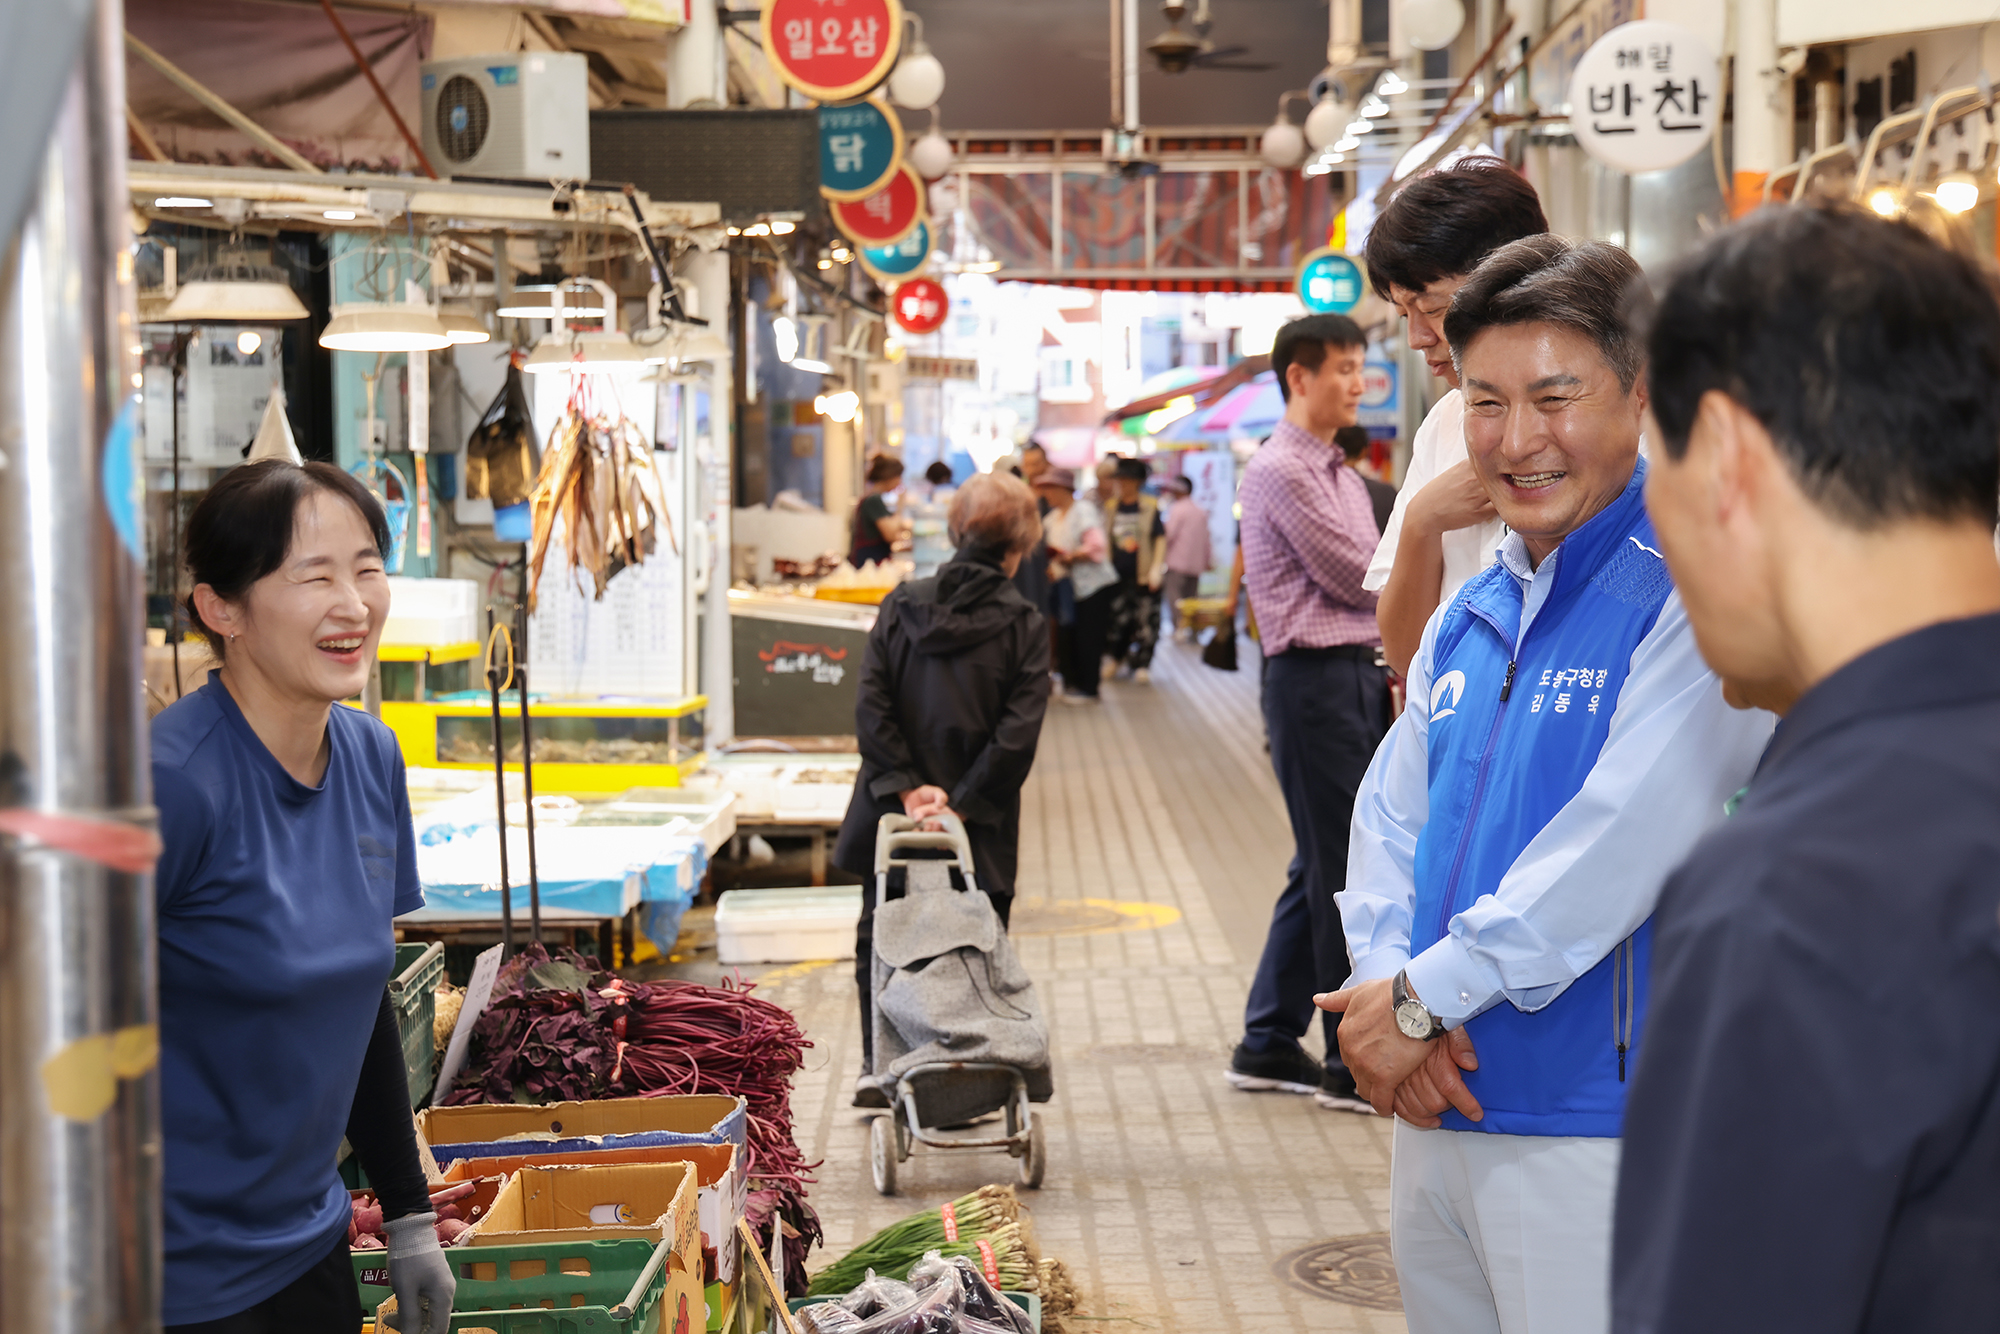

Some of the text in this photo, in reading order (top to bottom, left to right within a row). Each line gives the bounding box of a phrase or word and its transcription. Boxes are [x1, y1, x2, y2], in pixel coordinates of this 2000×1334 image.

[784, 15, 880, 60] 일오삼
[1614, 42, 1674, 73] 해밀
[1588, 78, 1709, 135] 반찬
[828, 133, 867, 173] 닭
[1538, 667, 1609, 689] 도봉구청장
